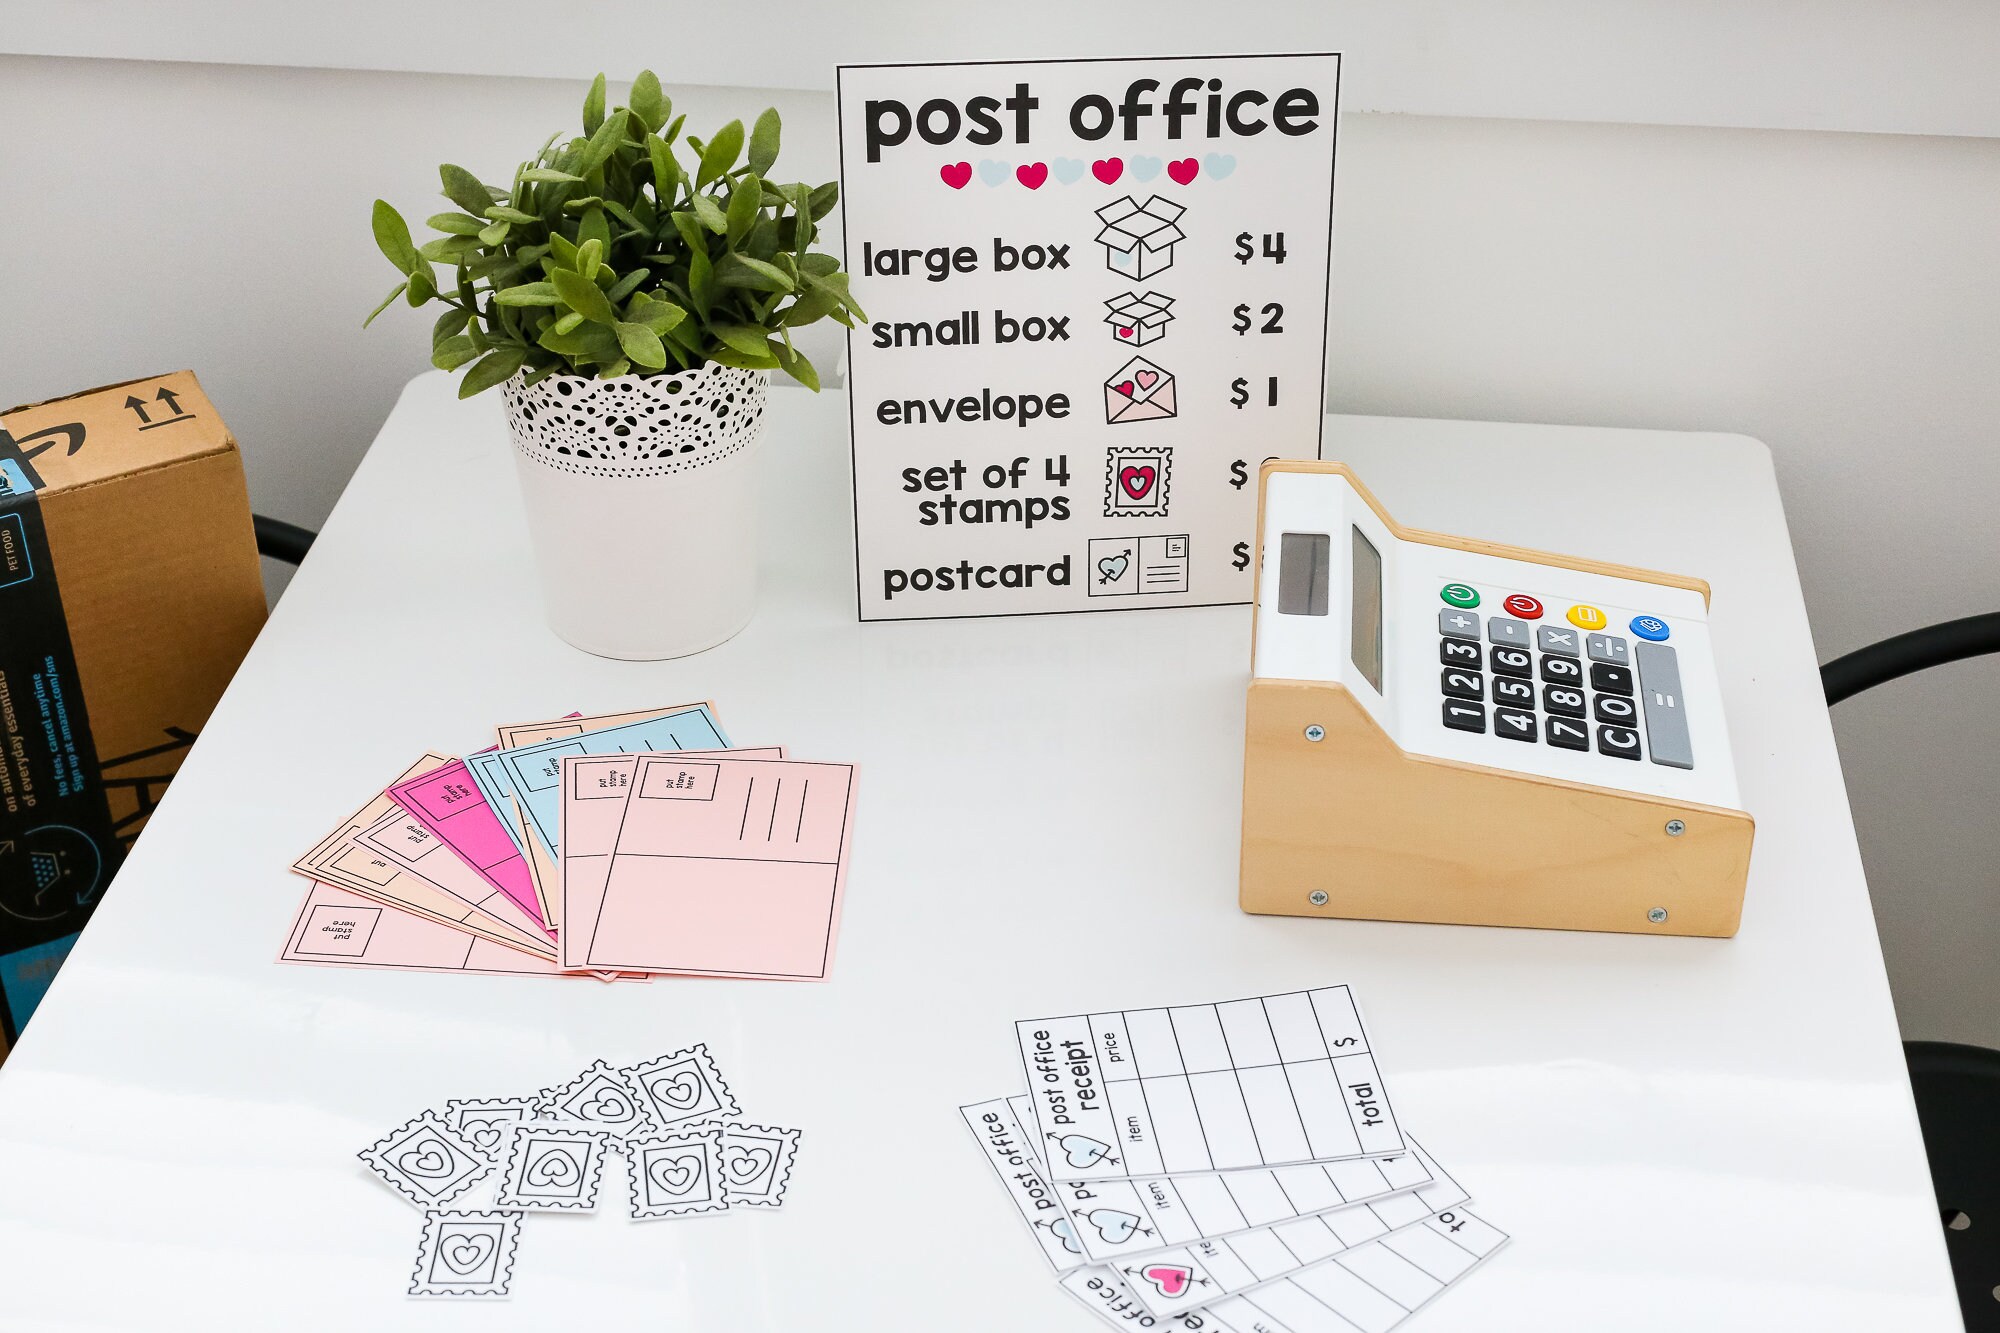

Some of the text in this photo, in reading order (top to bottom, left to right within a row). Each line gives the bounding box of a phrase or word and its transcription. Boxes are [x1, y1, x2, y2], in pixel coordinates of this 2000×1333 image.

[865, 77, 1320, 163] post office
[863, 237, 1071, 283] large box
[872, 308, 1071, 349] small box
[876, 388, 1071, 428] envelope
[902, 455, 1071, 493] set of 4
[918, 491, 1071, 529] stamps
[1, 529, 19, 571] PET FOOD
[884, 555, 1071, 601] postcard
[1447, 642, 1478, 659] 3
[1500, 650, 1529, 667] 6
[1548, 660, 1578, 676] 9
[1449, 674, 1480, 691] 2
[1500, 681, 1531, 698] 5
[1550, 690, 1582, 707] 8
[1450, 705, 1482, 716] 1
[44, 655, 84, 792] Sign up at amazon.com/sns
[1502, 713, 1533, 732] 4
[1554, 721, 1585, 738] 7
[32, 672, 69, 797] No fees, cancel anytime
[1605, 729, 1637, 748] C
[11, 736, 33, 791] everyday
[542, 768, 554, 777] put
[599, 778, 608, 788] put
[609, 769, 618, 788] stamp
[619, 773, 627, 787] here
[666, 778, 675, 789] put
[676, 771, 688, 789] stamp
[685, 776, 695, 790] here
[6, 795, 17, 812] on
[22, 794, 36, 807] of
[406, 825, 430, 839] stamp
[407, 835, 424, 844] put
[371, 859, 387, 868] put
[322, 926, 353, 934] stamp
[332, 920, 356, 928] here
[1104, 1031, 1125, 1063] price
[1333, 1036, 1358, 1047] $
[1033, 1029, 1076, 1125] post office
[1060, 1040, 1100, 1111] receipt
[1348, 1082, 1383, 1127] total
[1127, 1115, 1143, 1143] item
[982, 1111, 1057, 1211] post office
[1148, 1181, 1171, 1210] item
[1086, 1277, 1156, 1328] office
